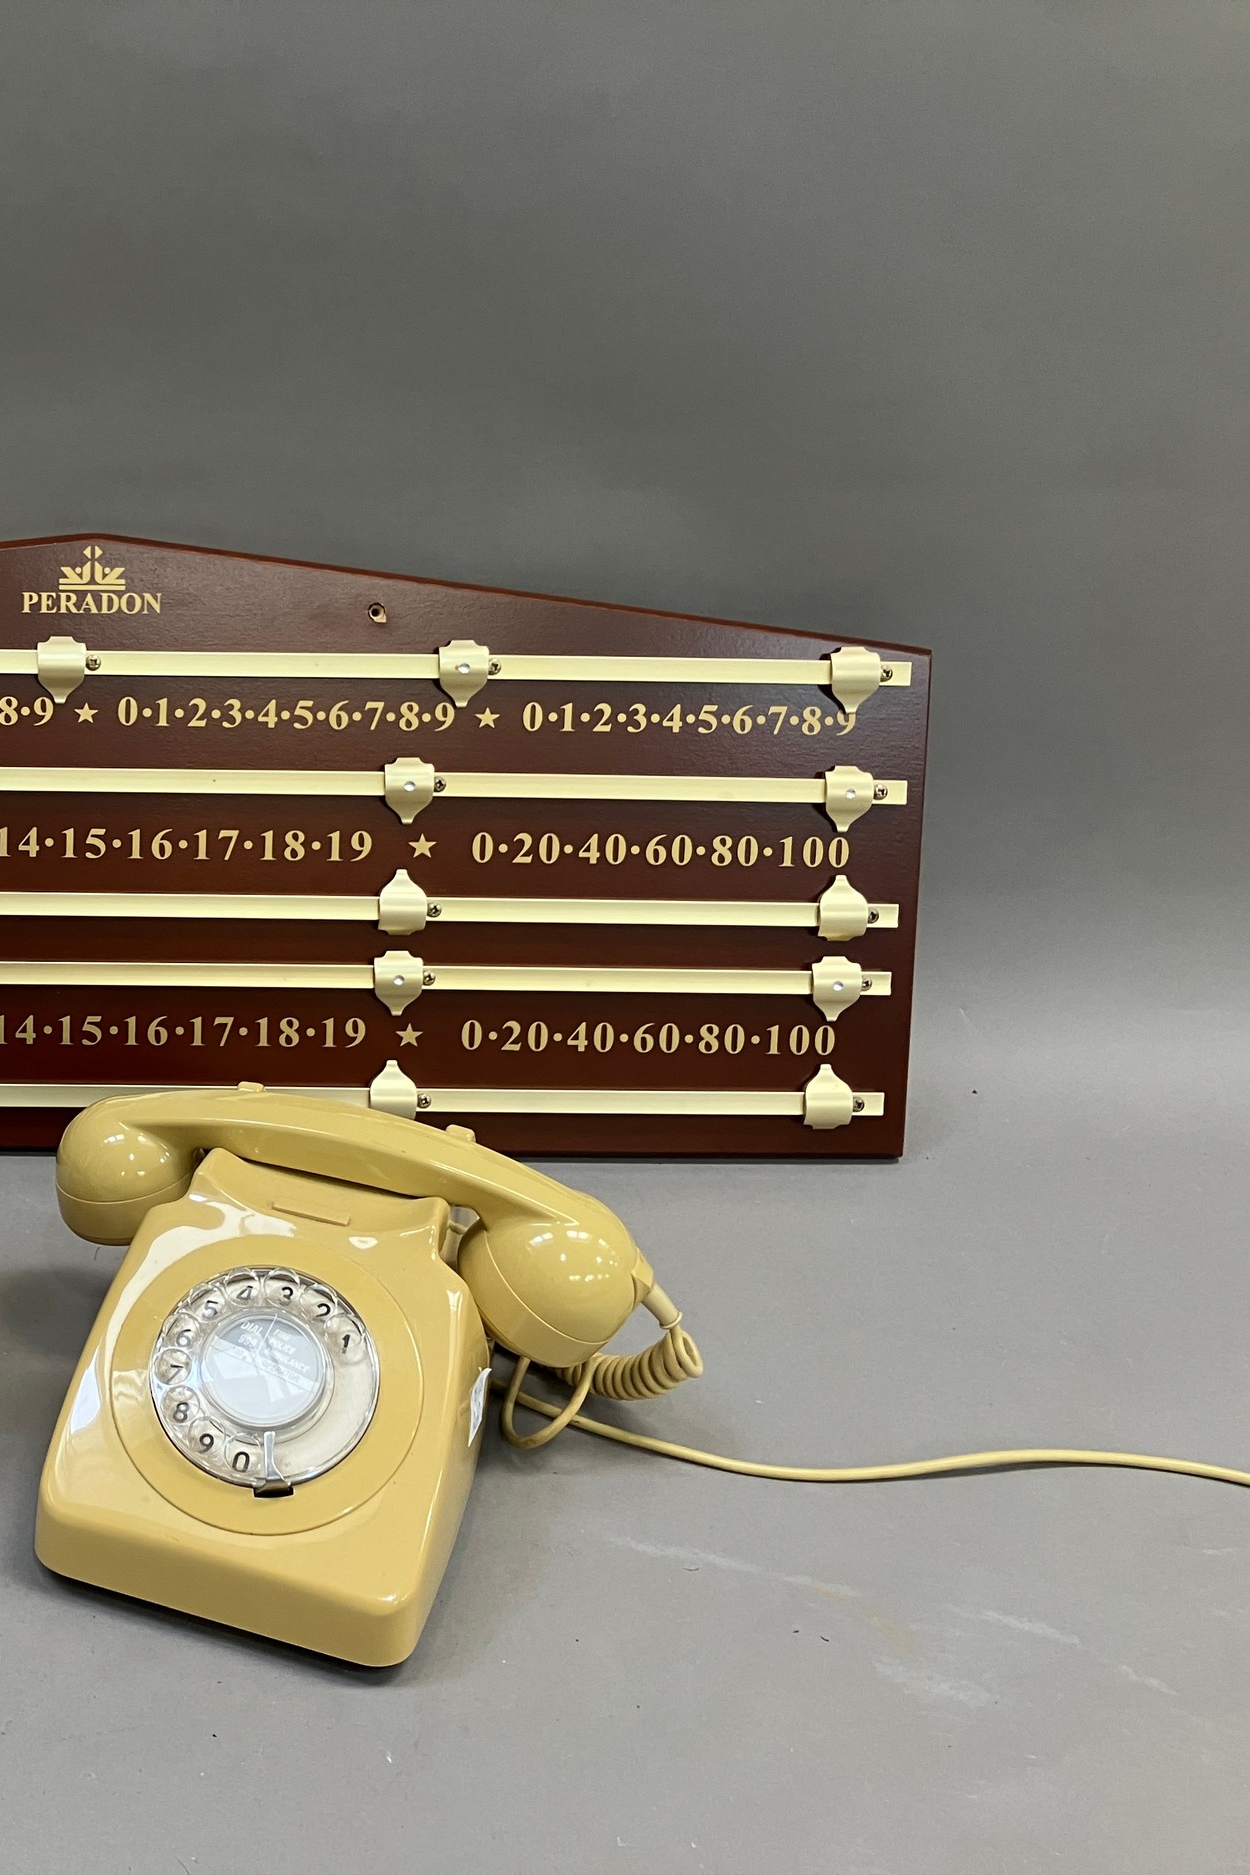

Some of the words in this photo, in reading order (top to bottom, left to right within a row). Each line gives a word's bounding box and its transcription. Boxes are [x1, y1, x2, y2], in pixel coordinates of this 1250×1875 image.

[21, 591, 163, 615] PERADON
[236, 1285, 253, 1300] 4
[281, 1286, 294, 1301] 3
[203, 1300, 219, 1318] 5
[314, 1302, 331, 1320] 2
[175, 1328, 191, 1347] 6
[240, 1321, 263, 1336] DIAL
[238, 1334, 258, 1348] 999
[341, 1334, 350, 1354] 1
[170, 1363, 184, 1385] 7
[172, 1402, 189, 1423] 8
[199, 1433, 214, 1453] 9
[232, 1451, 250, 1473] 0
